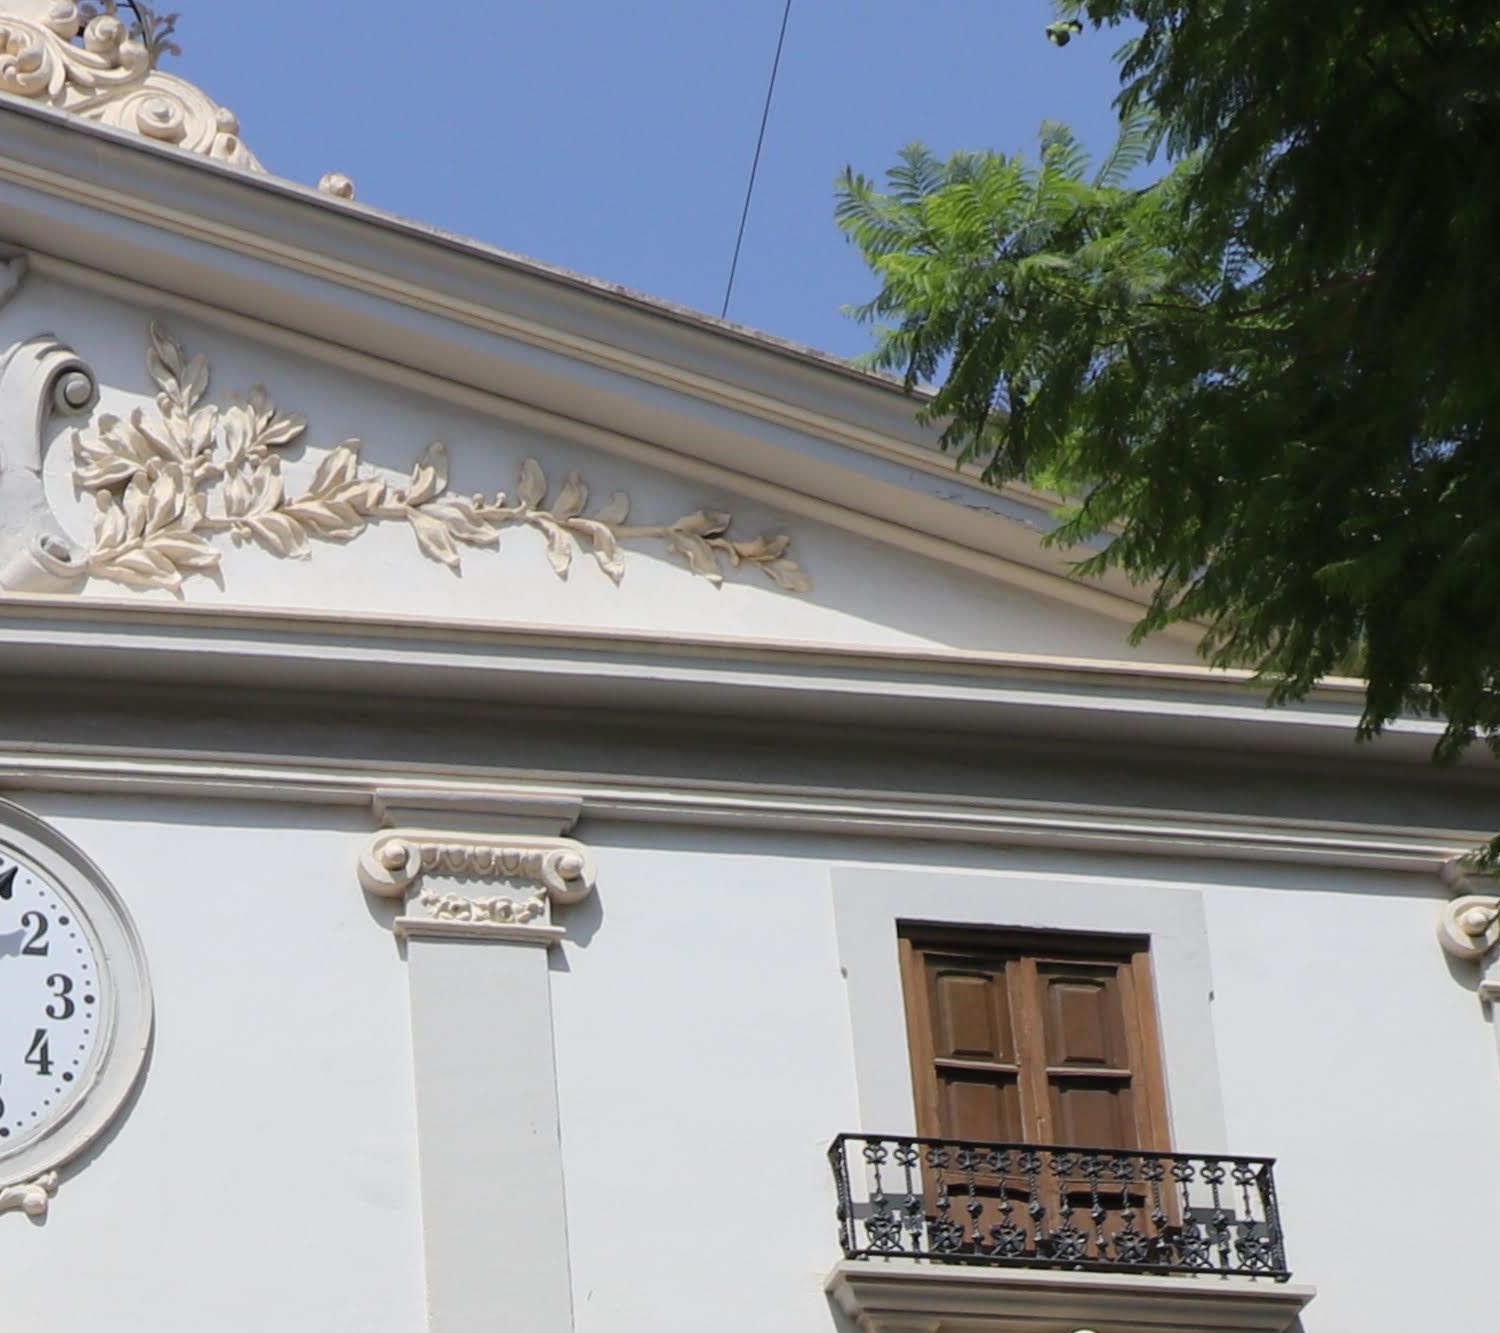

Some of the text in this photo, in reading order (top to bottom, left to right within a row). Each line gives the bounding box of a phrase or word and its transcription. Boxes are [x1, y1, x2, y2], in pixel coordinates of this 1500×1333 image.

[21, 911, 50, 956] 2
[45, 974, 75, 1019] 3
[24, 1029, 53, 1075] 4
